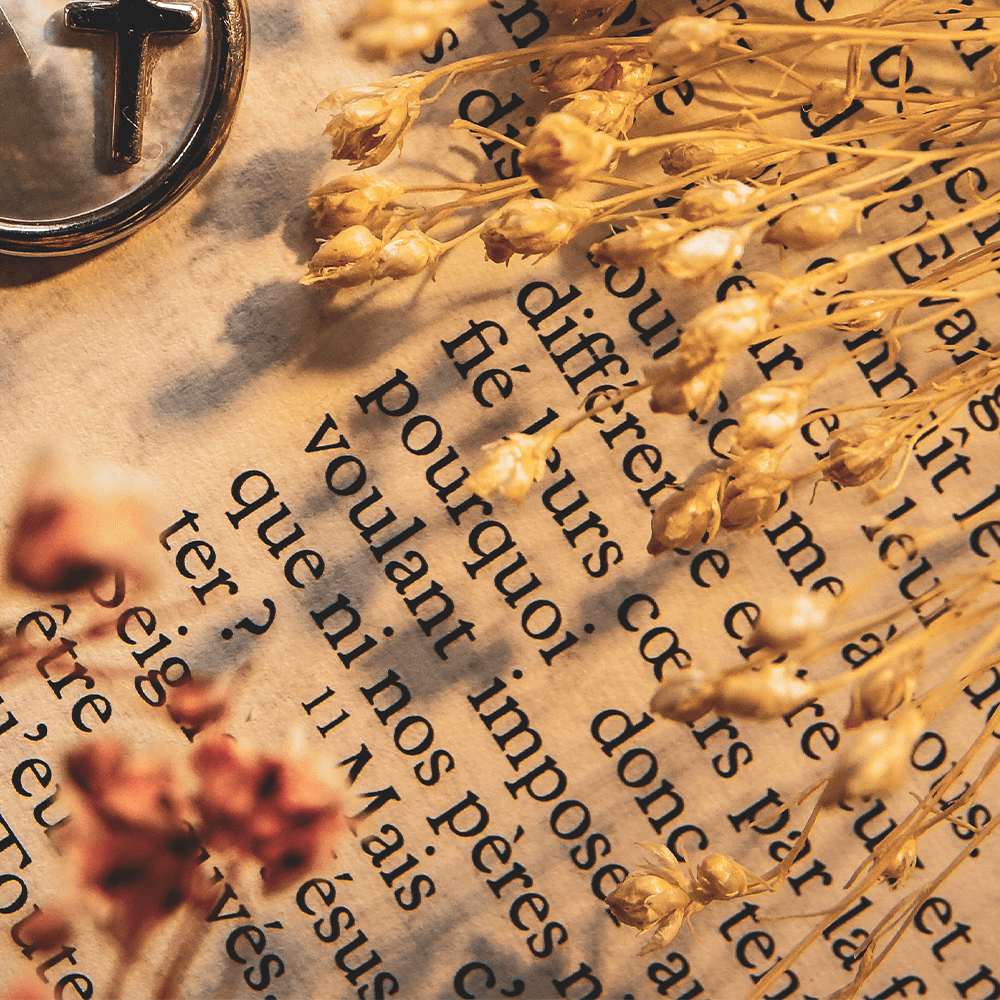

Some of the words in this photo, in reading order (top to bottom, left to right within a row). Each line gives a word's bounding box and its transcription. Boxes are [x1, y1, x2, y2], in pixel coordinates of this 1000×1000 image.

[13, 587, 113, 734] être
[159, 509, 239, 607] ter
[220, 597, 277, 641] ?
[338, 743, 436, 912] Mais
[224, 469, 326, 590] que
[308, 592, 395, 670] ni
[358, 667, 456, 787] nos
[425, 790, 569, 960] pères
[304, 412, 477, 664] voulant
[353, 367, 597, 667] pourquoi
[590, 708, 710, 864] donc
[440, 319, 531, 409] fié
[726, 787, 833, 897] par
[821, 895, 874, 972] la
[912, 896, 972, 963] et
